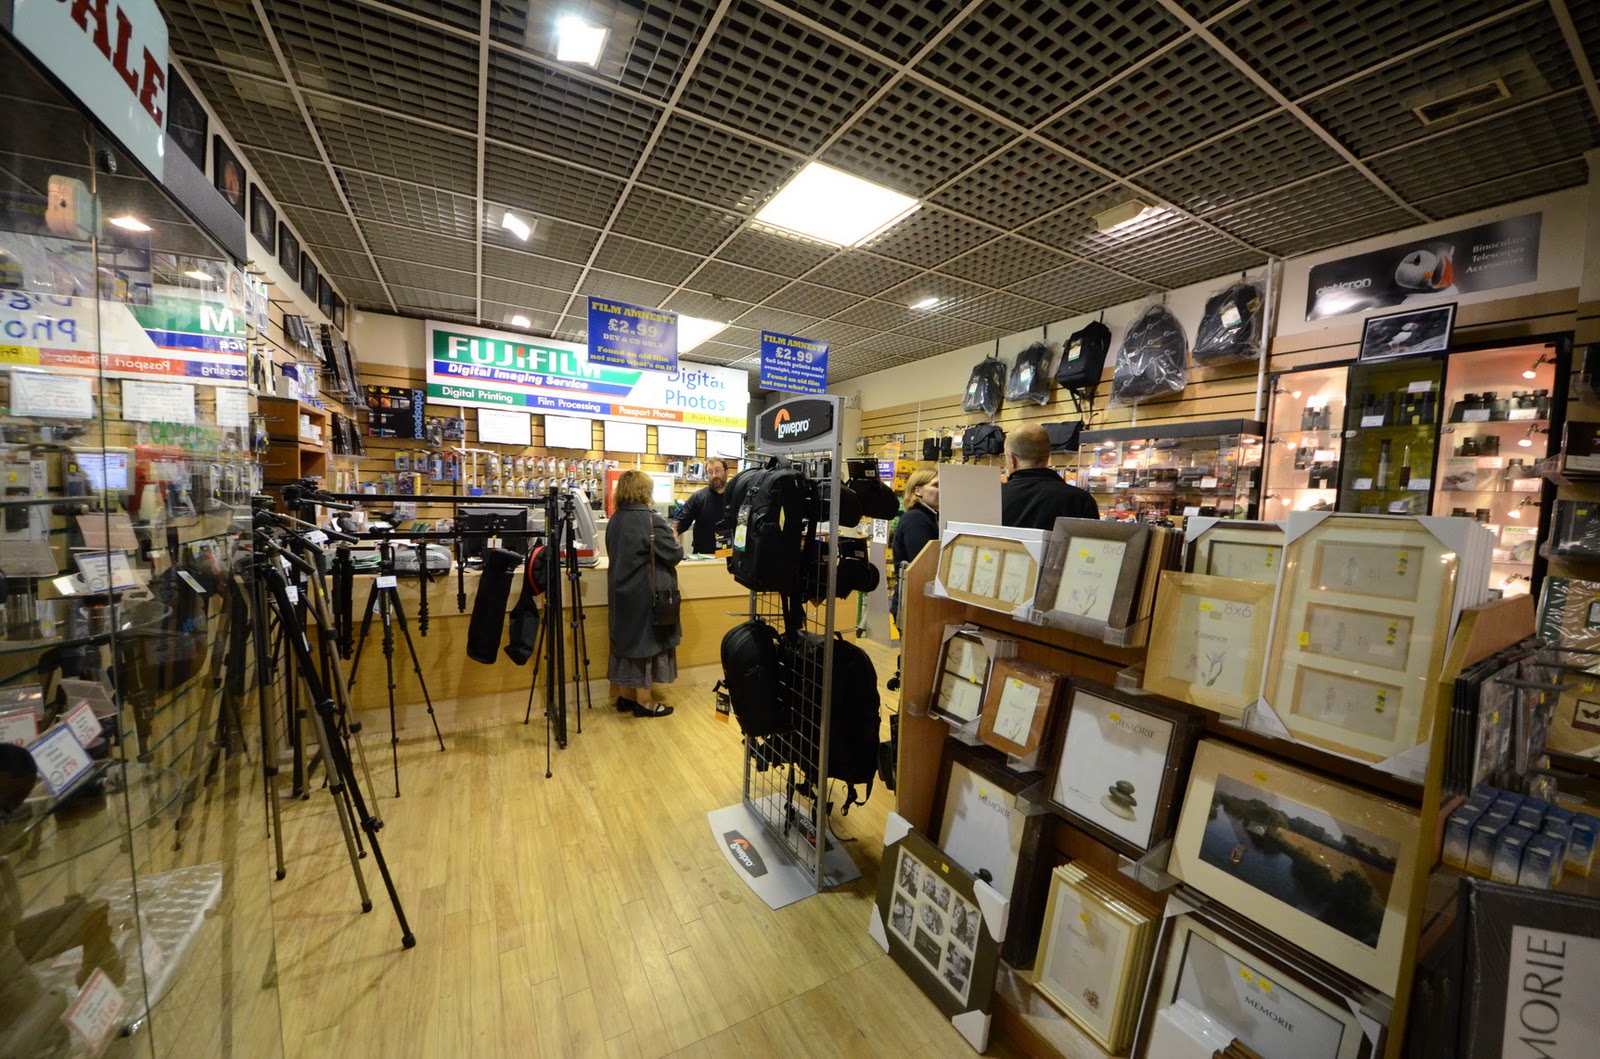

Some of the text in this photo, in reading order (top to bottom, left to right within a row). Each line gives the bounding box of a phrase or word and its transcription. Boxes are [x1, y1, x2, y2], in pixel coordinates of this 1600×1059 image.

[56, 0, 165, 129] ALE
[592, 302, 676, 324] FILM AMNESTY
[608, 318, 658, 337] £2.99
[602, 333, 620, 341] DEV
[642, 340, 663, 348] ONLY
[764, 334, 826, 352] FILM AMNESTY
[448, 336, 601, 378] FUJIFILM
[597, 346, 624, 356] Found
[638, 352, 652, 360] old
[654, 354, 670, 362] film
[776, 346, 813, 363] £2.99
[626, 359, 654, 368] what's
[777, 358, 792, 367] inch
[792, 362, 811, 370] prints
[812, 366, 824, 374] only
[448, 364, 588, 390] Digital Imaging Service
[766, 372, 788, 381] Found
[442, 386, 514, 404] Digital Printing
[665, 390, 726, 411] Photos
[538, 396, 601, 413] Film Processing
[618, 406, 676, 420] Passport Photos
[412, 389, 425, 440] Fotospeed
[692, 414, 706, 422] Print
[778, 419, 810, 439] Lowepro
[1224, 602, 1252, 618] 8x6
[730, 842, 753, 867] Lowepro
[1245, 996, 1294, 1032] MEMORIE
